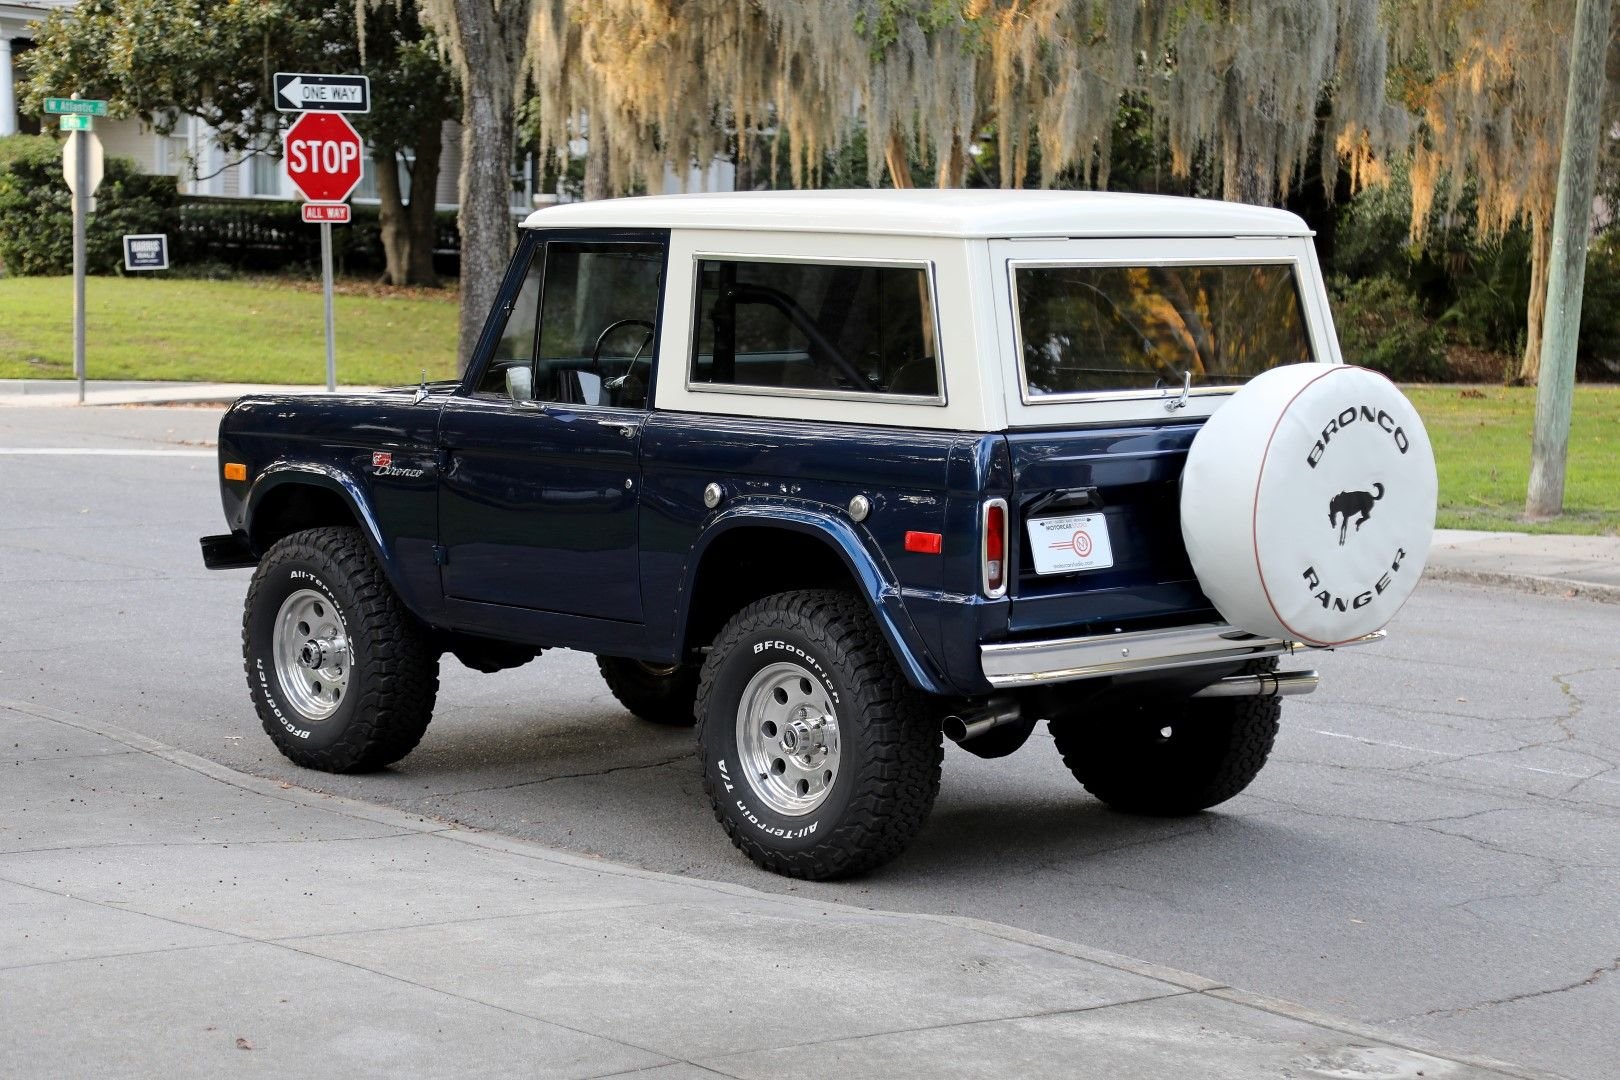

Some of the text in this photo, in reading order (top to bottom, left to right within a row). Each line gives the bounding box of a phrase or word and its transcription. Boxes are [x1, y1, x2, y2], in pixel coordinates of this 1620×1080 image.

[60, 101, 93, 113] Atlantic
[304, 87, 357, 101] ONE WAY
[290, 140, 358, 174] STOP
[306, 208, 346, 218] ALL WAY
[131, 240, 160, 252] HARRIS
[1307, 405, 1410, 469] BRONCO
[290, 570, 347, 626] All-Terrain
[1302, 547, 1406, 613] RANGER
[257, 658, 311, 740] BFGoodrich
[753, 640, 840, 704] BFGoodrich
[717, 759, 819, 839] All-Terrain T/A
